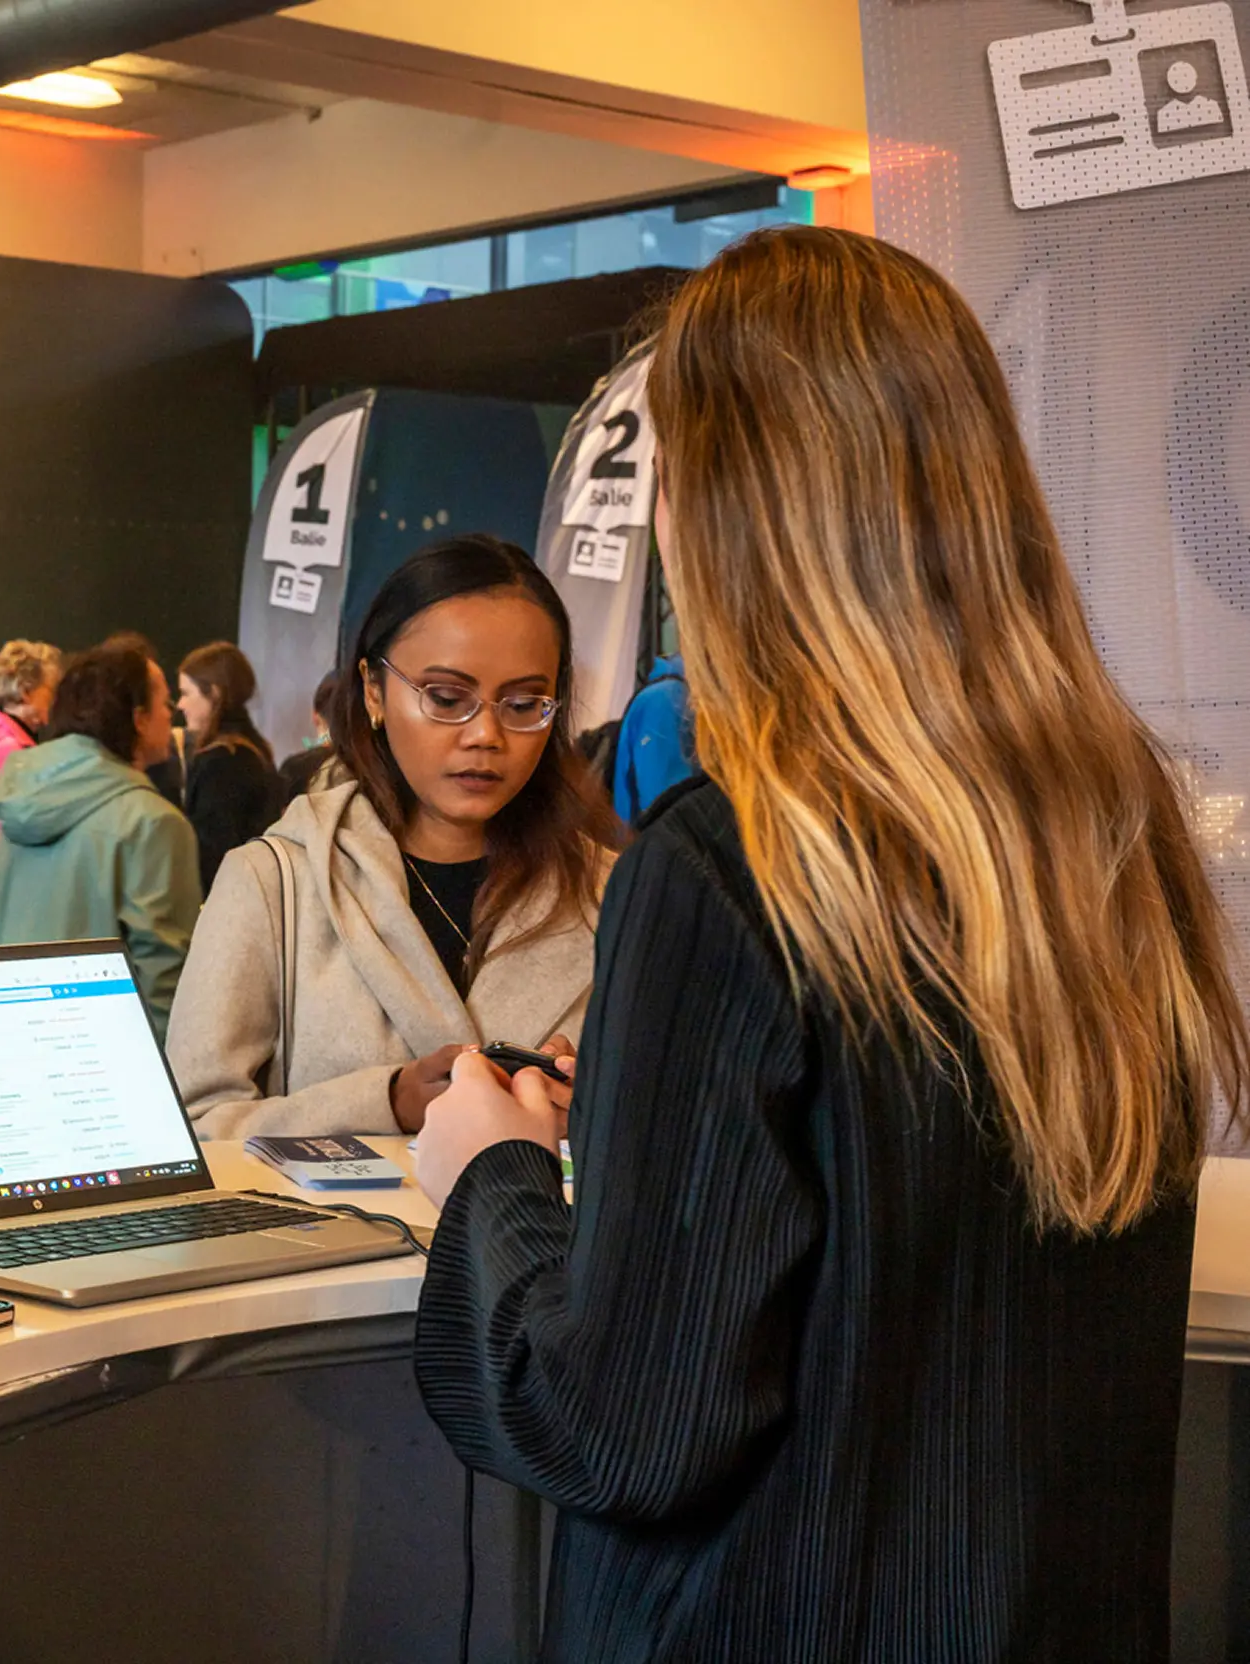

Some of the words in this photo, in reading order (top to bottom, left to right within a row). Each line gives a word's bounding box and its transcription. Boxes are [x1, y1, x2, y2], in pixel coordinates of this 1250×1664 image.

[590, 409, 640, 478] 2
[290, 462, 330, 525] 1
[290, 529, 327, 547] Balie
